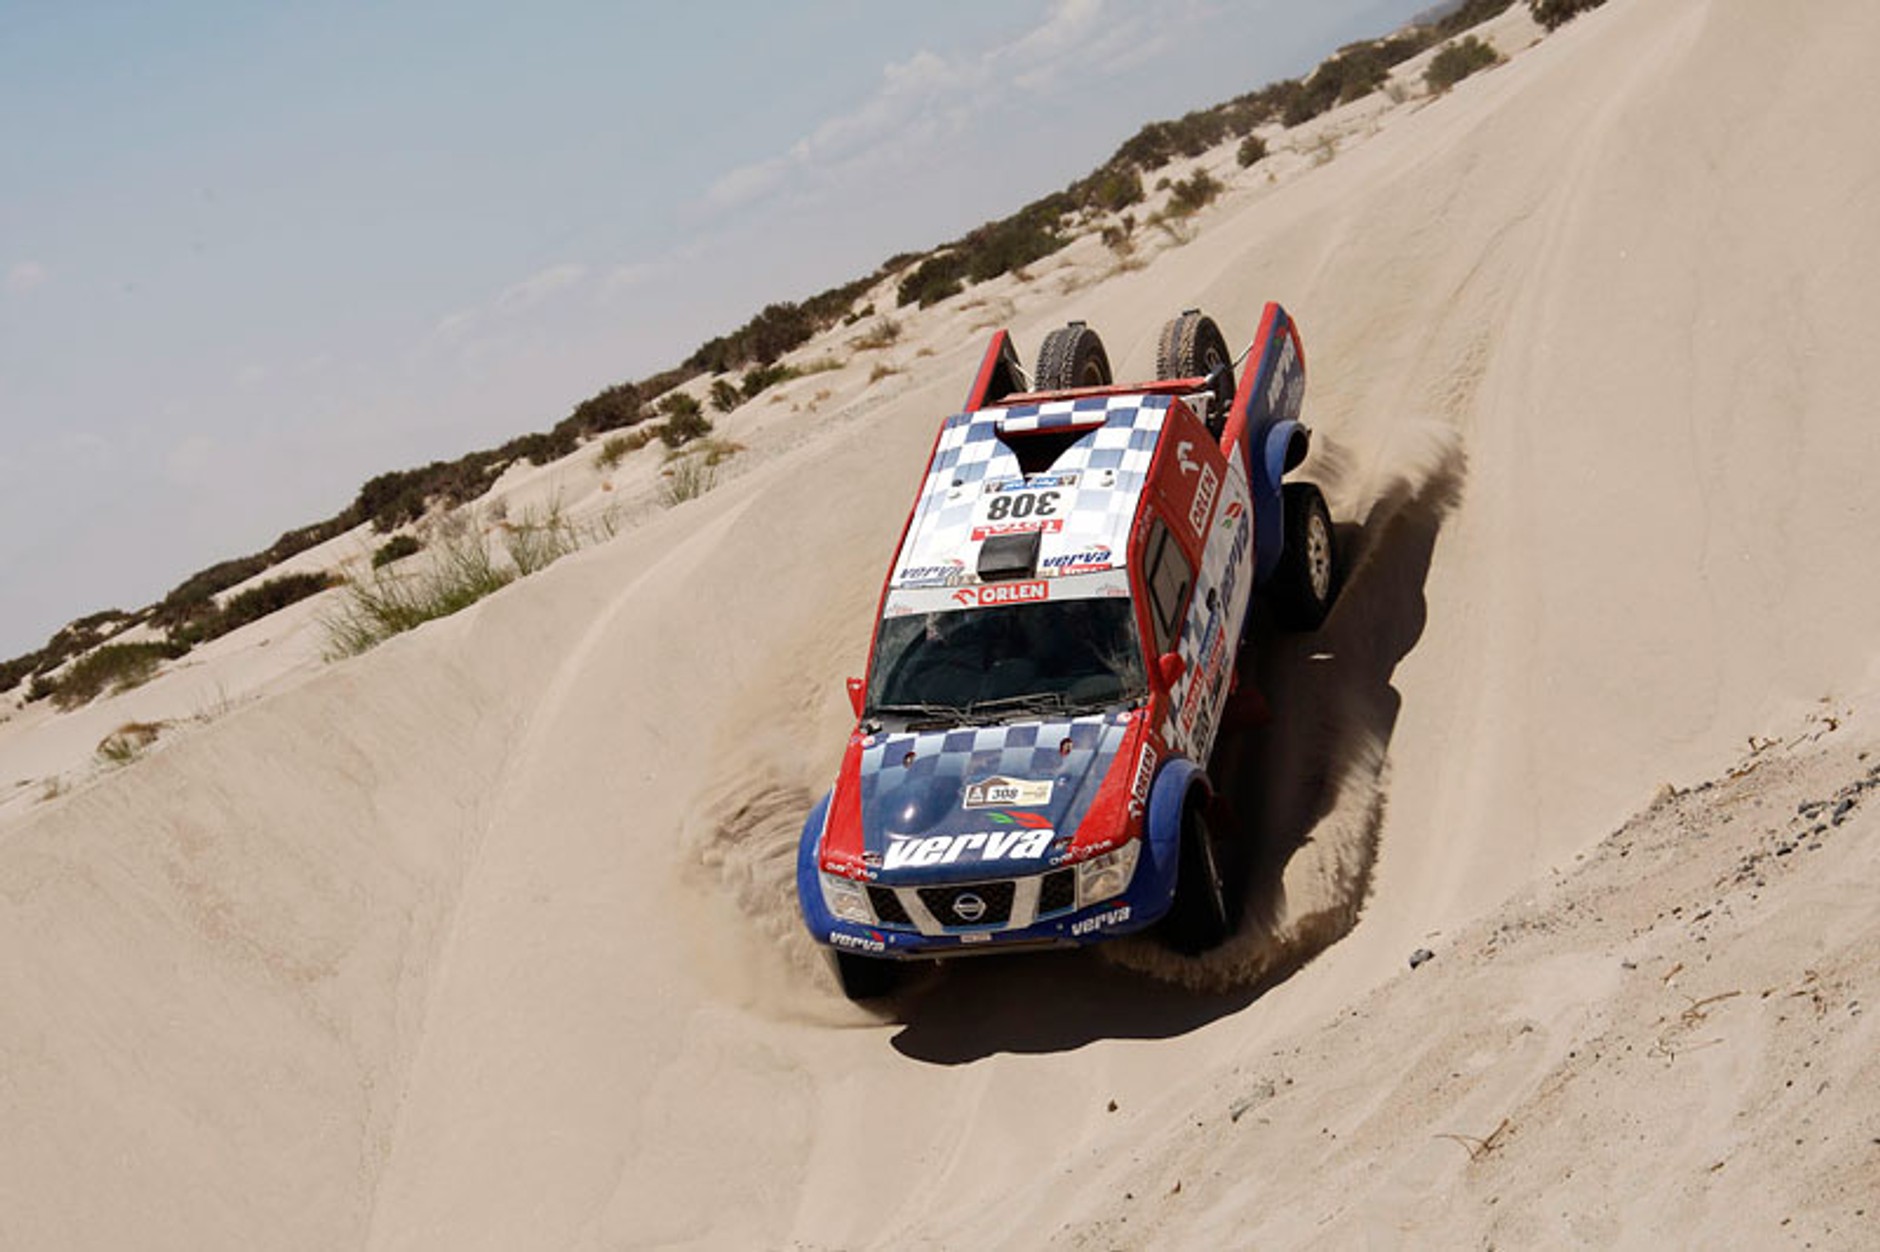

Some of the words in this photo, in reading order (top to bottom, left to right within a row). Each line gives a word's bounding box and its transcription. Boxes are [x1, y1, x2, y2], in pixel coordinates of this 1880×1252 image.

[987, 491, 1060, 520] 308
[1194, 468, 1215, 529] ORLEN
[1043, 550, 1111, 567] verva
[982, 584, 1044, 601] ORLEN
[992, 788, 1018, 800] 308
[882, 828, 1055, 870] verva
[1071, 906, 1130, 936] verva
[830, 930, 884, 952] verva
